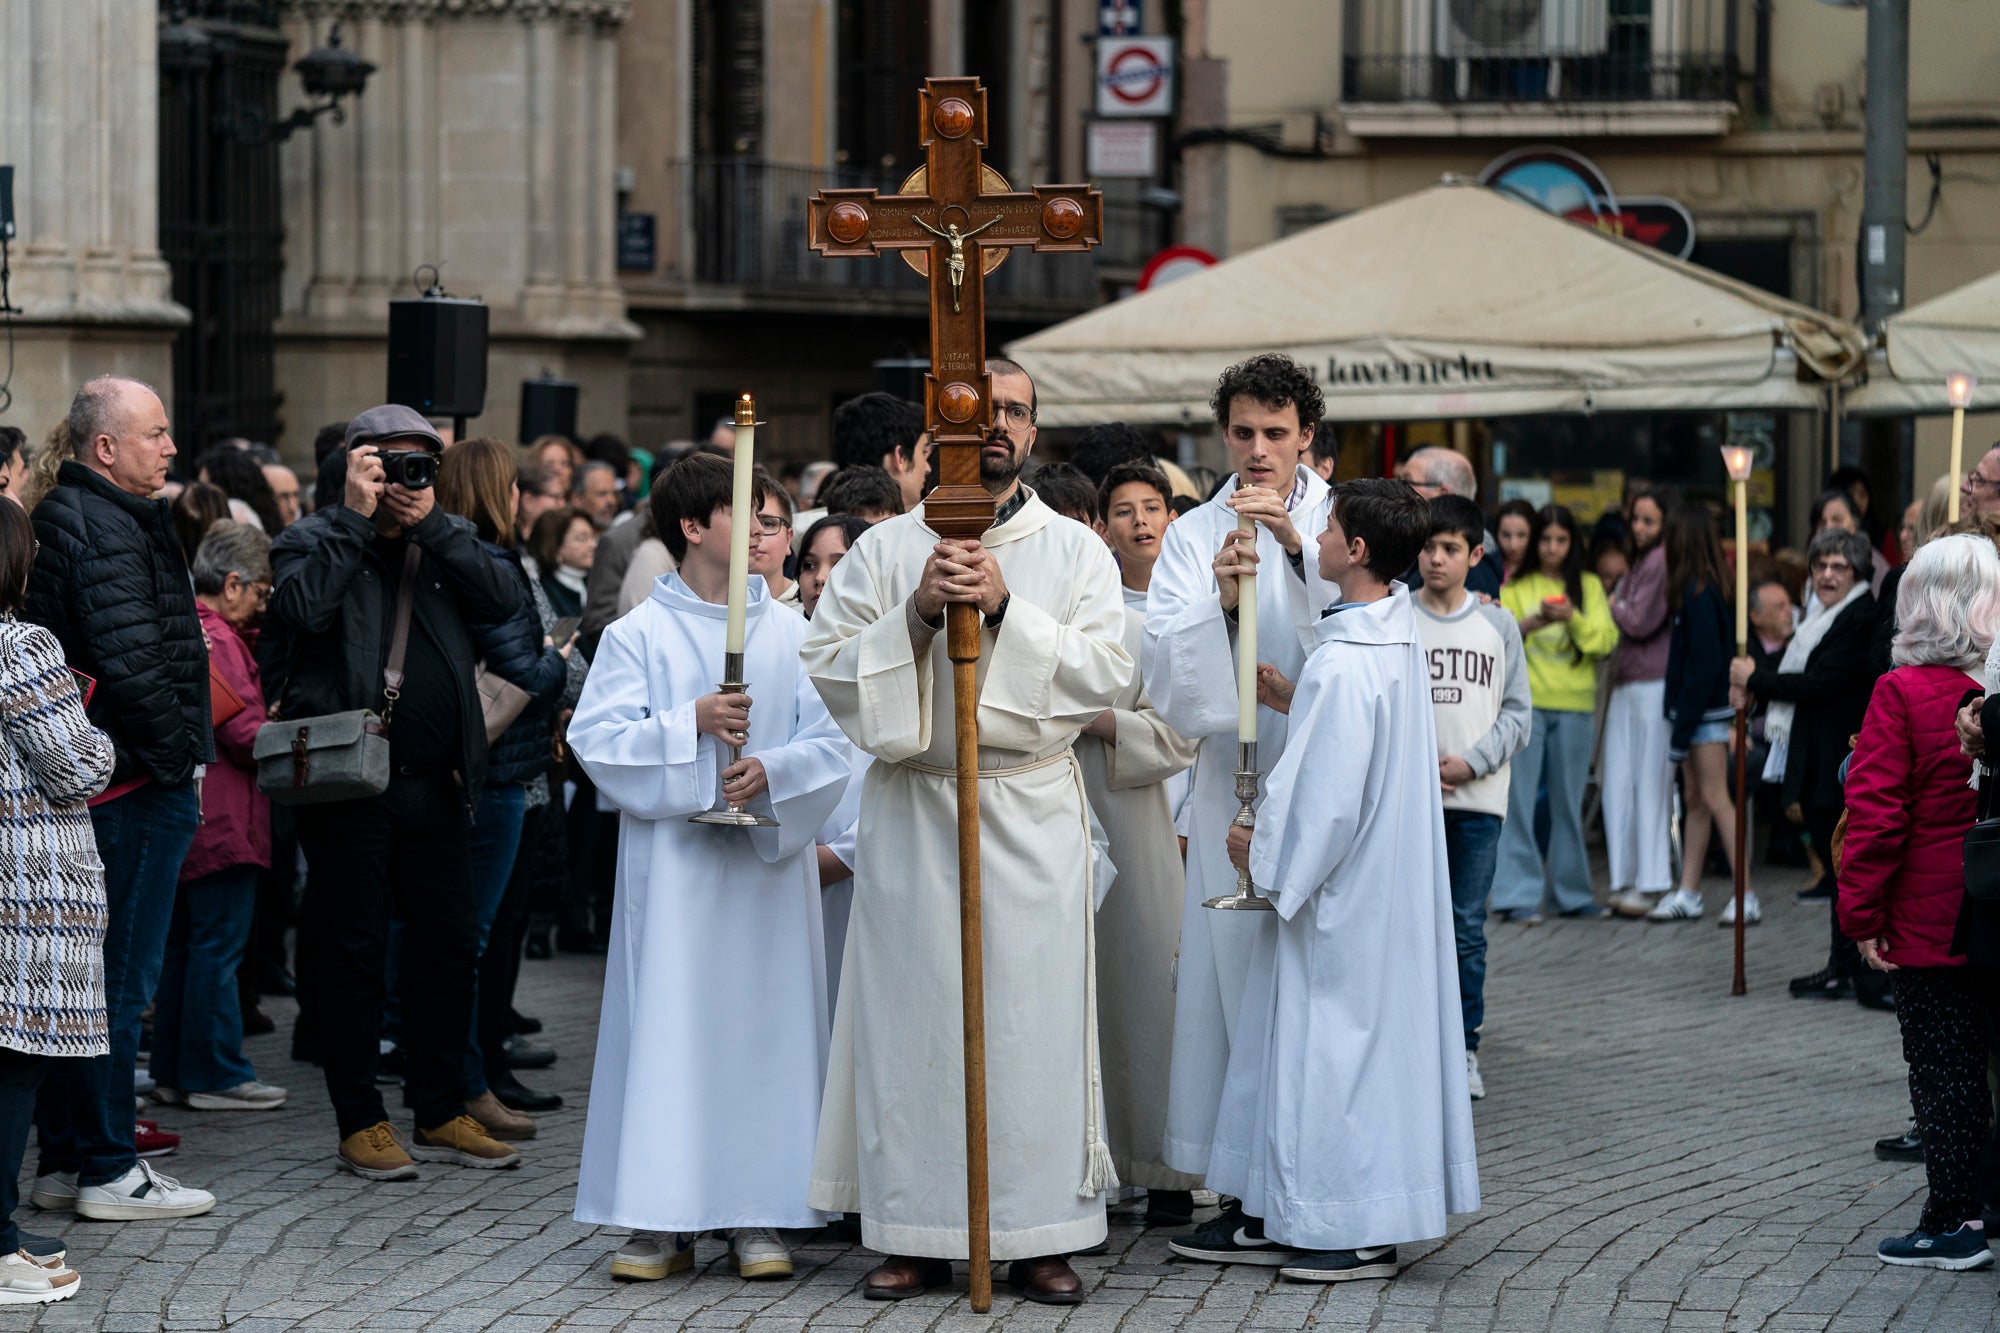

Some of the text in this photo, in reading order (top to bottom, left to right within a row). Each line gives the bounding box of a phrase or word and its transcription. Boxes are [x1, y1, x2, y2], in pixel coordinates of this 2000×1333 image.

[943, 352, 970, 361] VITAM
[1425, 648, 1495, 689] STON
[1433, 690, 1459, 702] 1993
